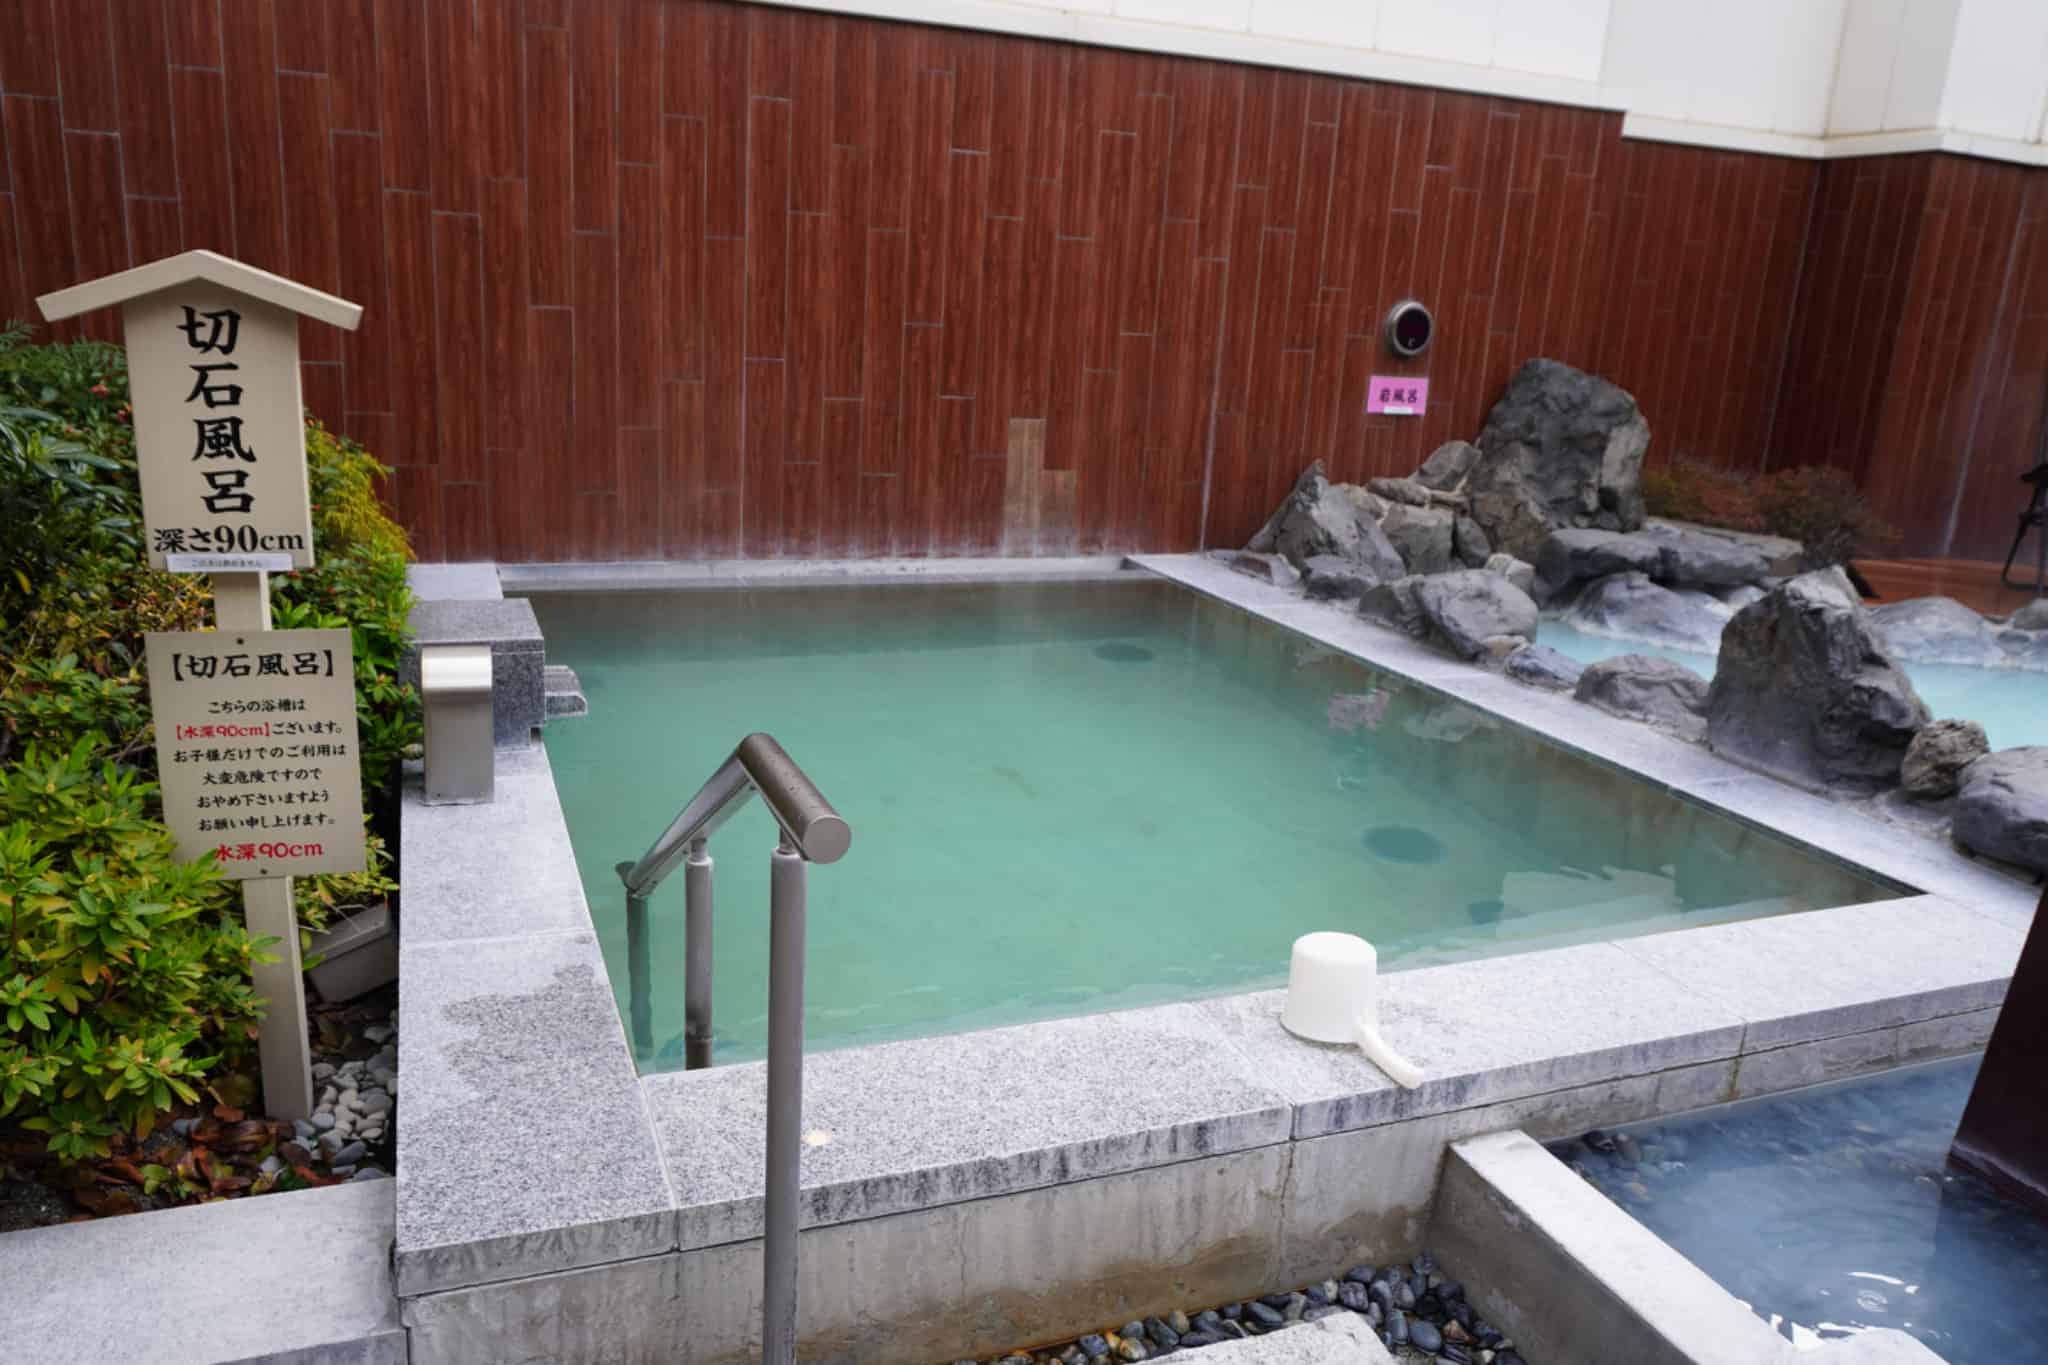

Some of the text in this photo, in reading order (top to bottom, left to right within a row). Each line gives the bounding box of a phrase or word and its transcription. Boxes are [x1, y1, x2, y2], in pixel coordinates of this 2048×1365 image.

[177, 306, 257, 515] 切石風呂
[154, 525, 305, 554] 深さ90cm
[172, 649, 334, 682] 【切石風呂】
[207, 698, 305, 715] こちらの浴槽は
[173, 743, 347, 764] お子様だけでのご利用は
[204, 767, 322, 787] 大変危険ですので
[196, 789, 329, 810] おやめ下さいますよう
[198, 813, 335, 832] お願い申し上げます。
[215, 841, 324, 862] 水深90cm
